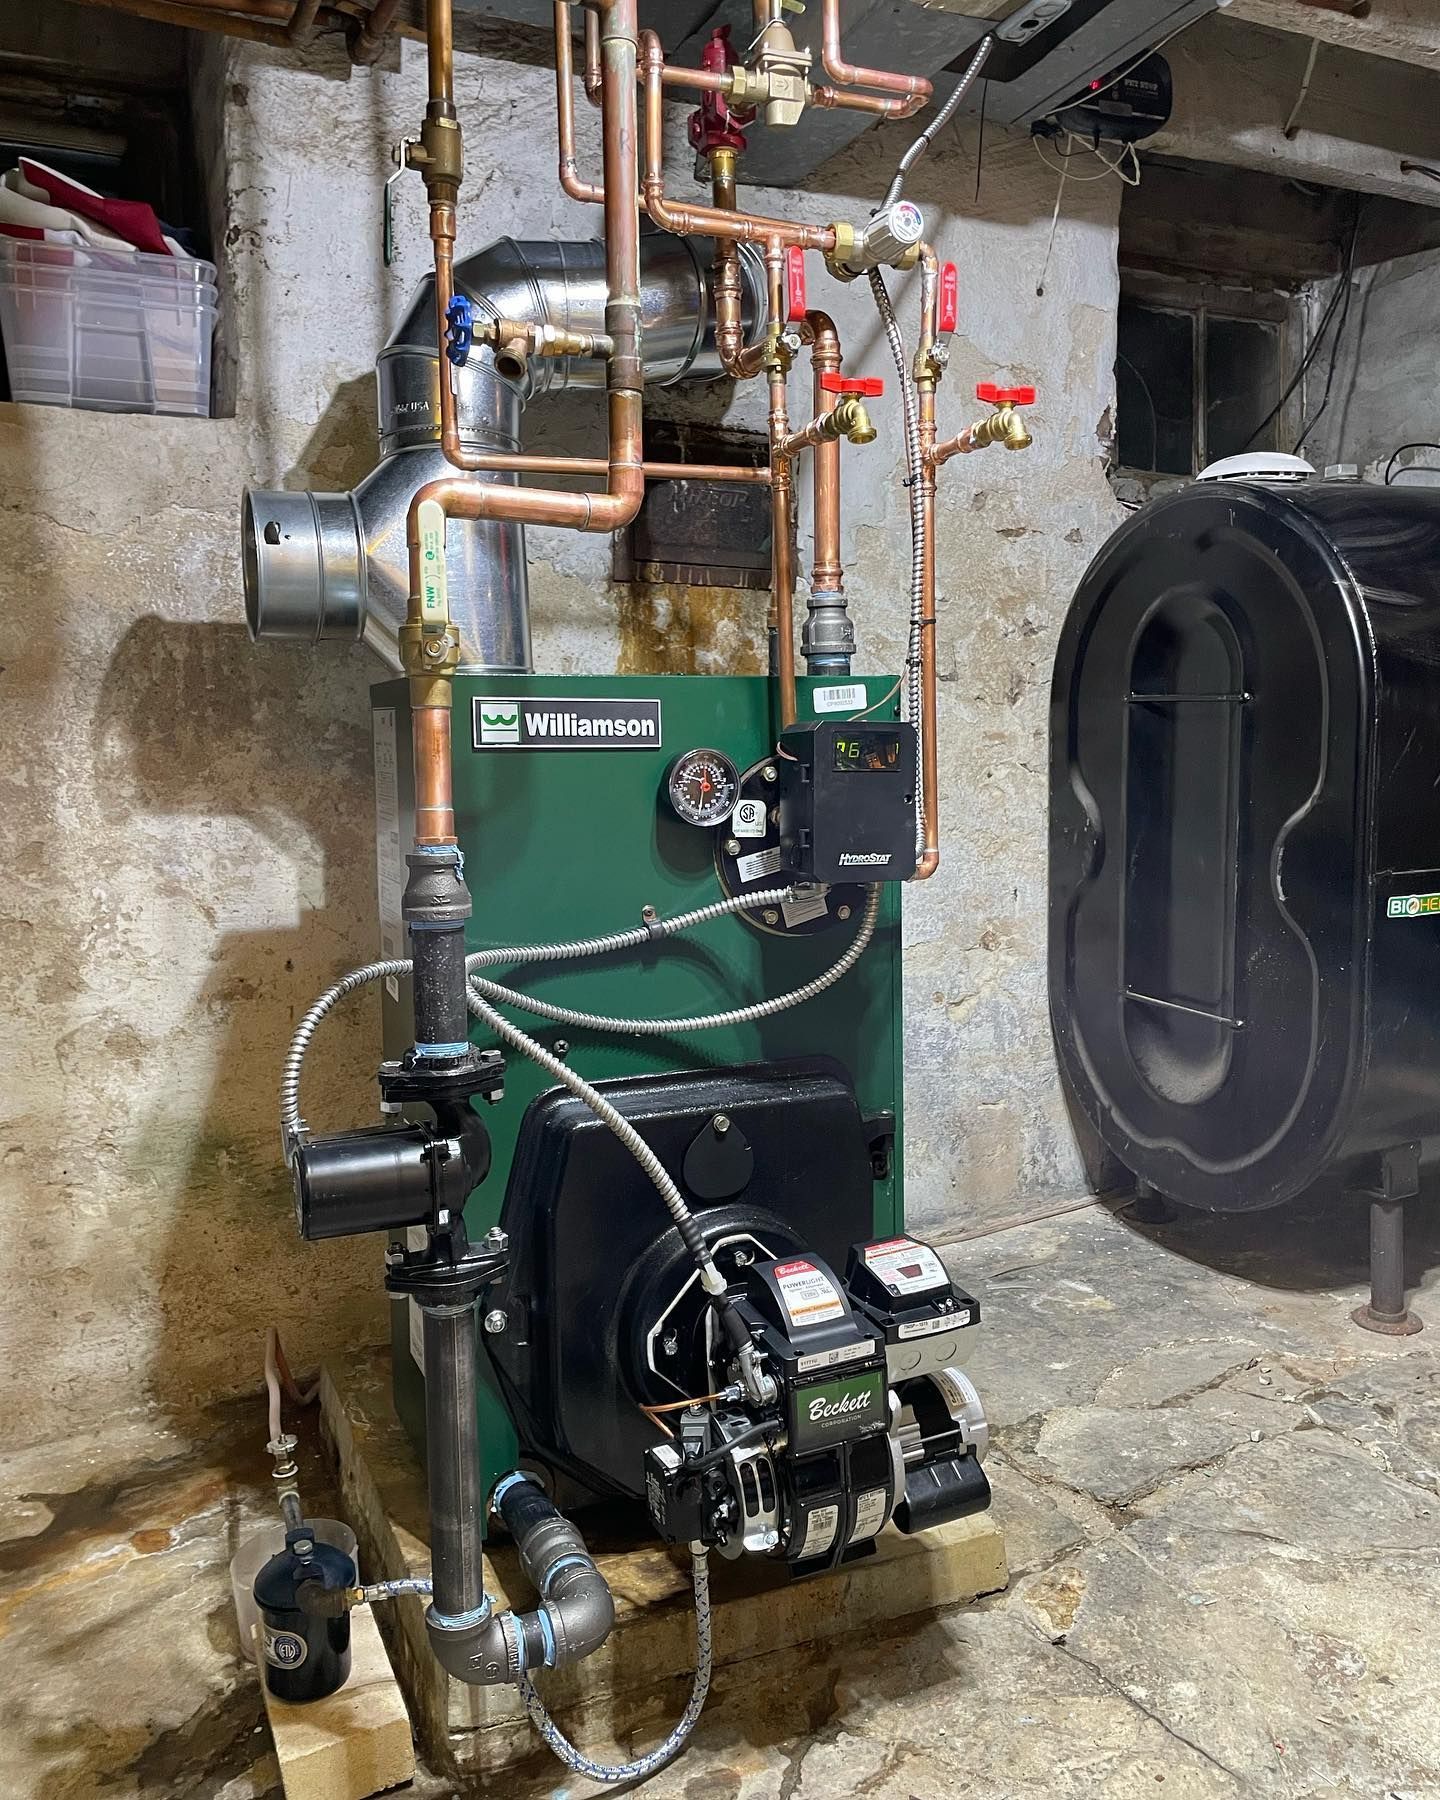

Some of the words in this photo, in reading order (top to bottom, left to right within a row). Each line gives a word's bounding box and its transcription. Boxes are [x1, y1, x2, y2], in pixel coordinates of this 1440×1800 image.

[426, 586, 435, 608] FNW
[525, 712, 656, 737] Williamson
[1390, 897, 1440, 915] BIOHE
[808, 1390, 872, 1421] Beckett
[821, 1414, 862, 1428] CORPORATION
